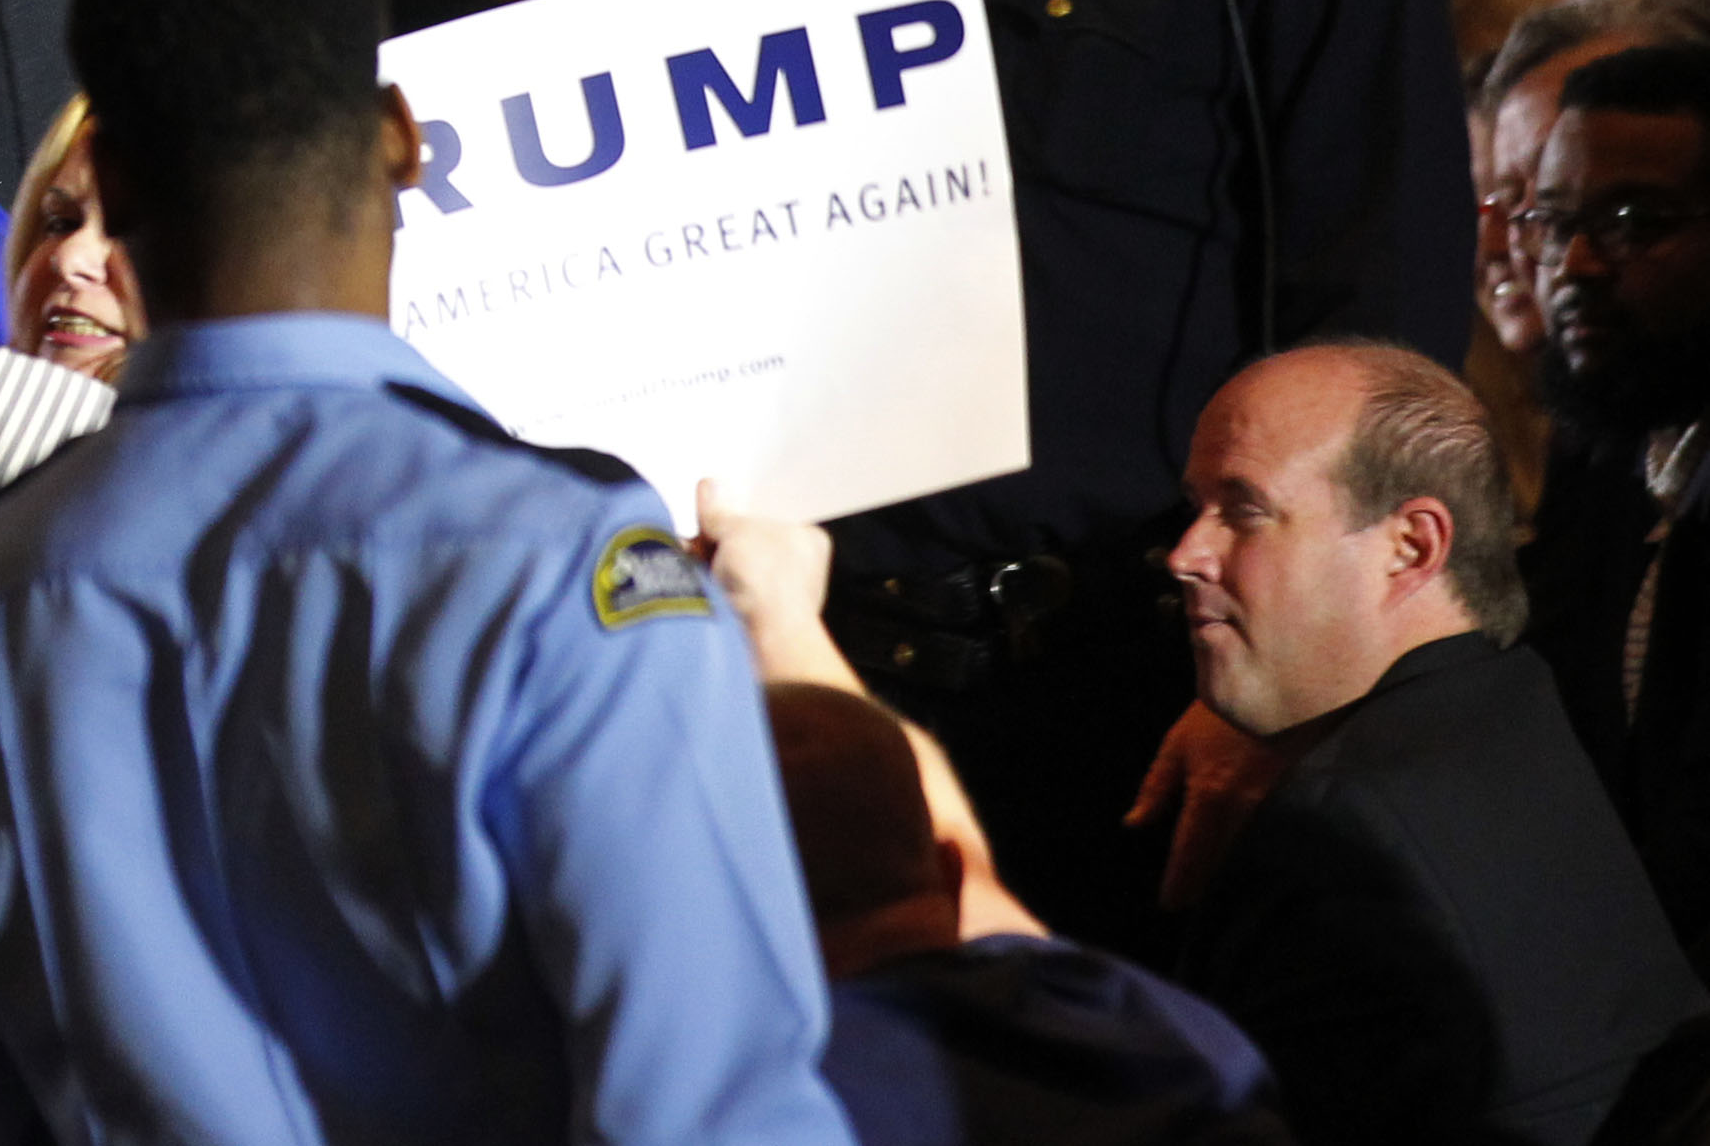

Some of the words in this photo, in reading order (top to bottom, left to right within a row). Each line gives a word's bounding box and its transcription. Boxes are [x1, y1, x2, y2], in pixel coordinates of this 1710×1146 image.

[391, 0, 966, 231] RUMP
[404, 245, 624, 341] AMERICA
[644, 198, 800, 268] GREAT
[825, 159, 992, 230] AGAIN!
